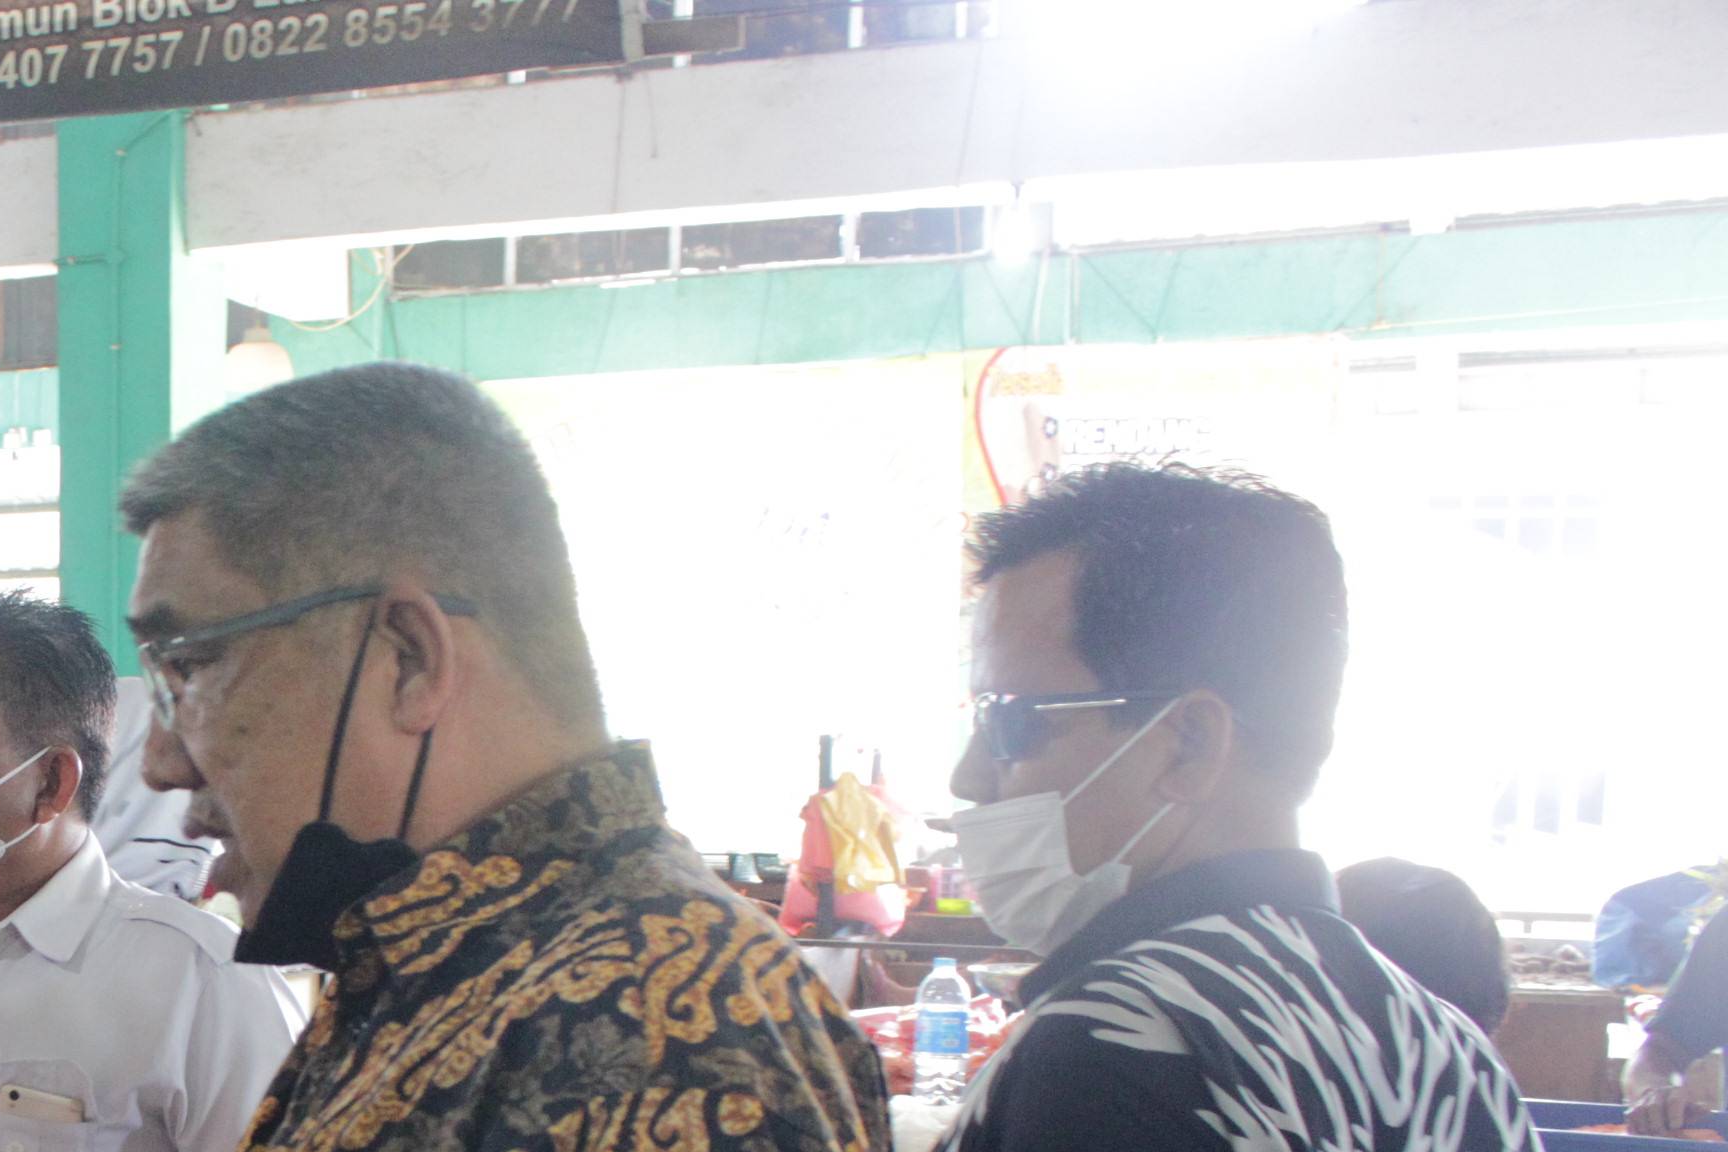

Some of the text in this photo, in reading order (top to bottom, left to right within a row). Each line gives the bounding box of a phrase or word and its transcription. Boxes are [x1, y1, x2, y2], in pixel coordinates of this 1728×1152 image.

[82, 30, 183, 80] 7757
[195, 25, 211, 66] /
[222, 13, 329, 62] 0822
[343, 0, 452, 48] 8554
